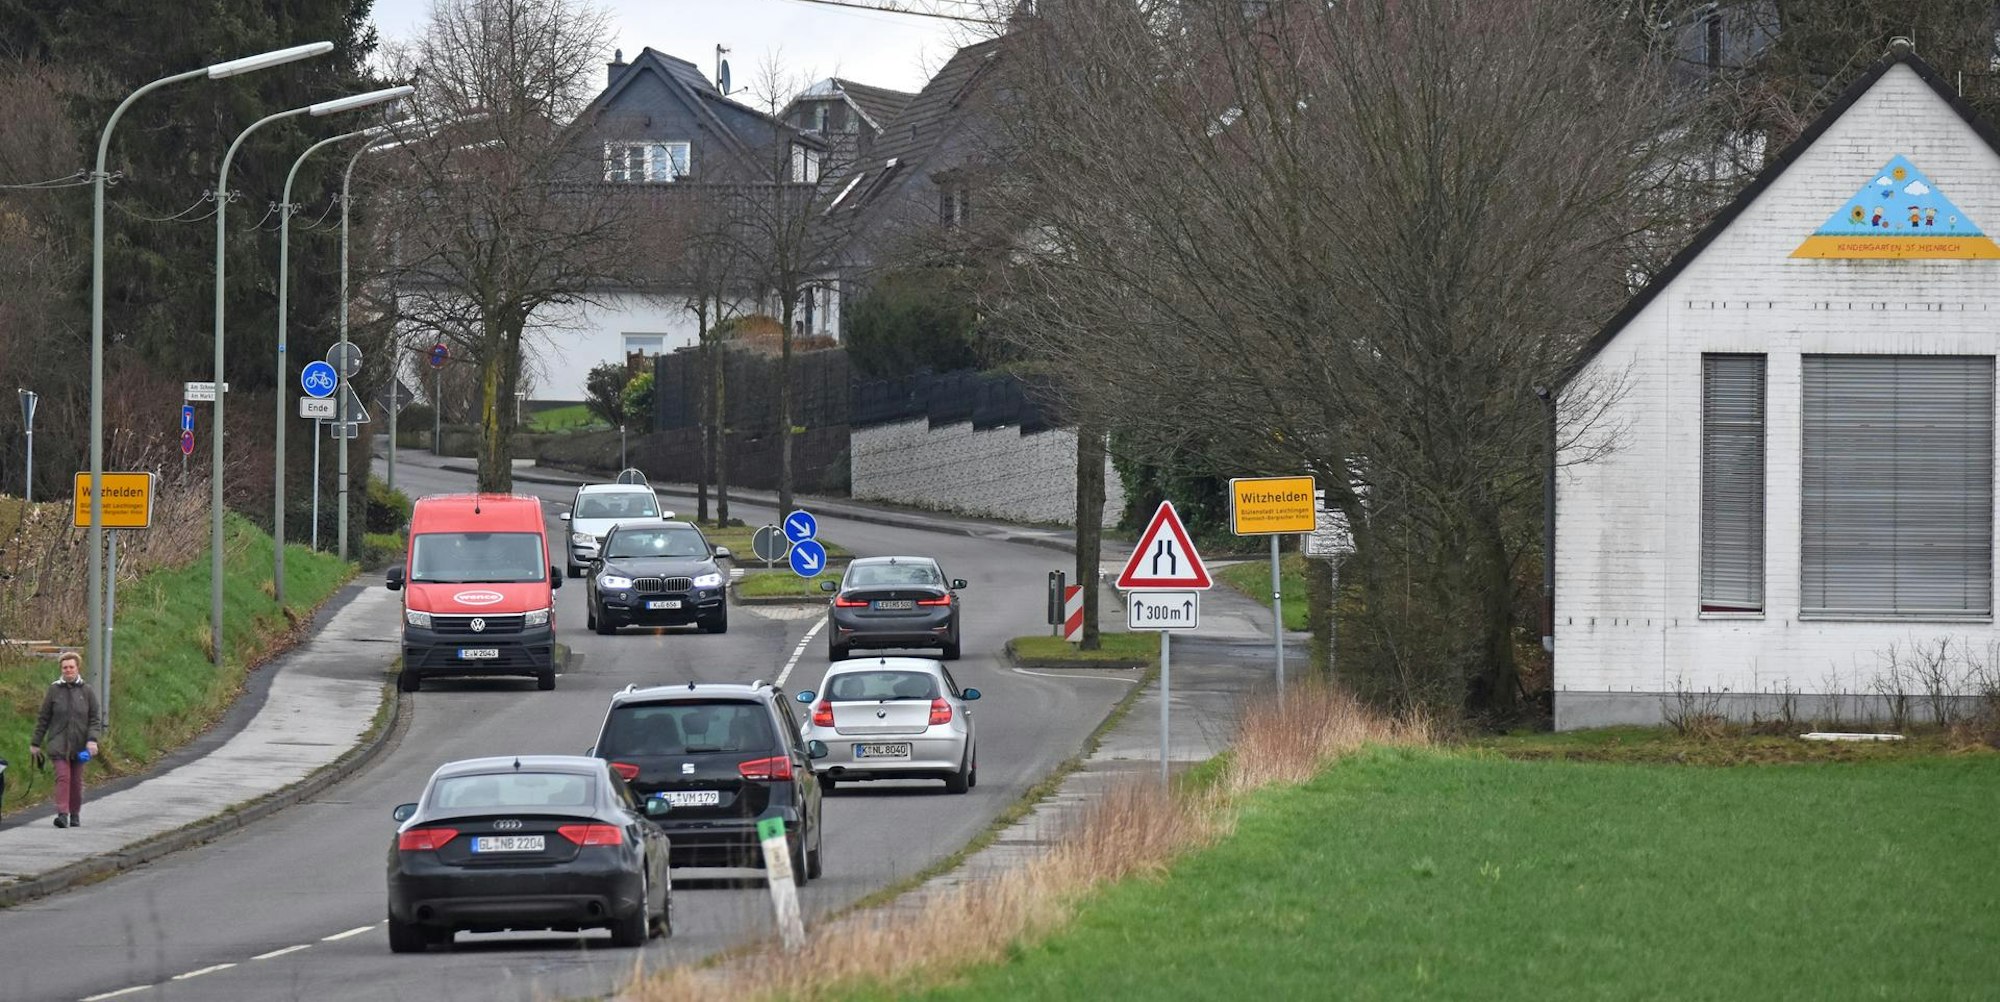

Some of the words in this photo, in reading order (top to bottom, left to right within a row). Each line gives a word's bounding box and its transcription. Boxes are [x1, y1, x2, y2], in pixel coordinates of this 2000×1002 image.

[1838, 244, 1901, 252] KINDERGARTEN
[307, 403, 328, 412] Ende
[82, 487, 144, 497] Wzhelden
[1241, 492, 1308, 504] Witzhelden
[885, 745, 906, 754] 8040
[699, 792, 717, 802] 179
[517, 838, 543, 849] 2204
